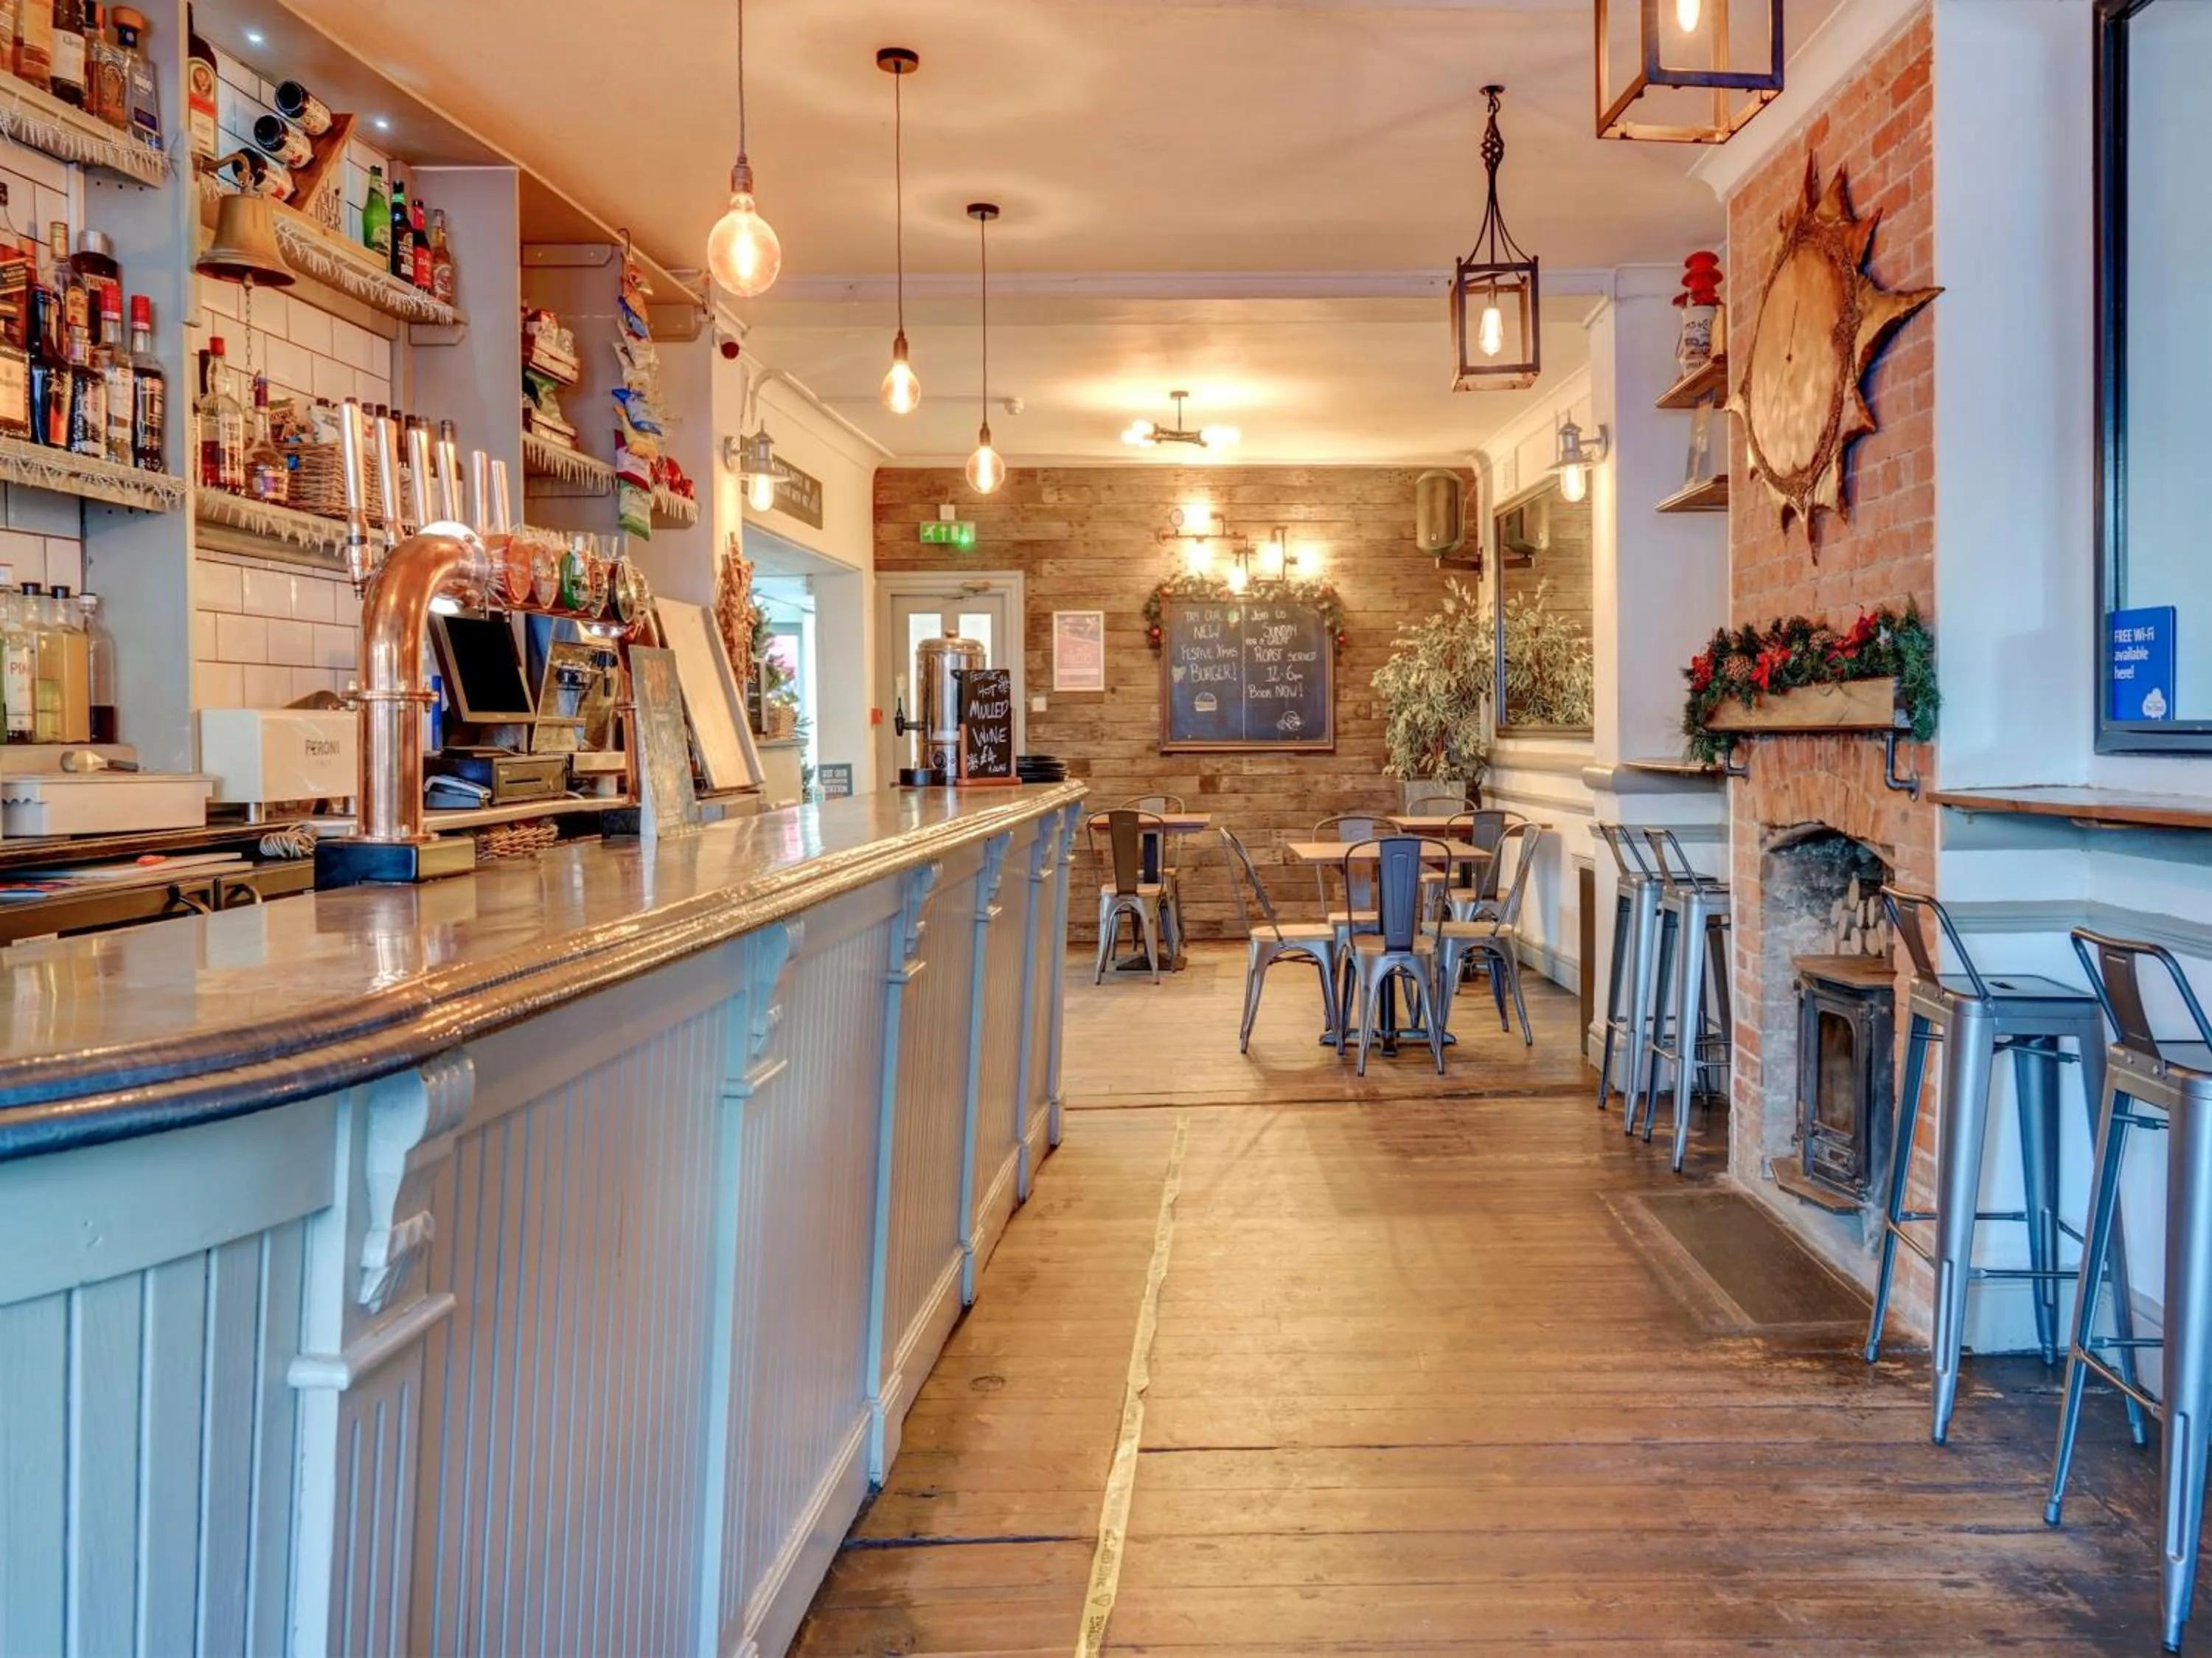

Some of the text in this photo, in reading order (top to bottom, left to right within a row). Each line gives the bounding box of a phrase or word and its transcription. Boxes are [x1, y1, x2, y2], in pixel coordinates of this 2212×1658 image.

[1193, 624, 1220, 640] NEW
[2115, 628, 2132, 643] FREE
[1254, 645, 1284, 662] ROAST
[2115, 645, 2149, 661] available
[977, 684, 998, 698] HOT
[969, 699, 1009, 720] MULLED
[973, 725, 1007, 747] WINE
[305, 739, 341, 756] PERONI
